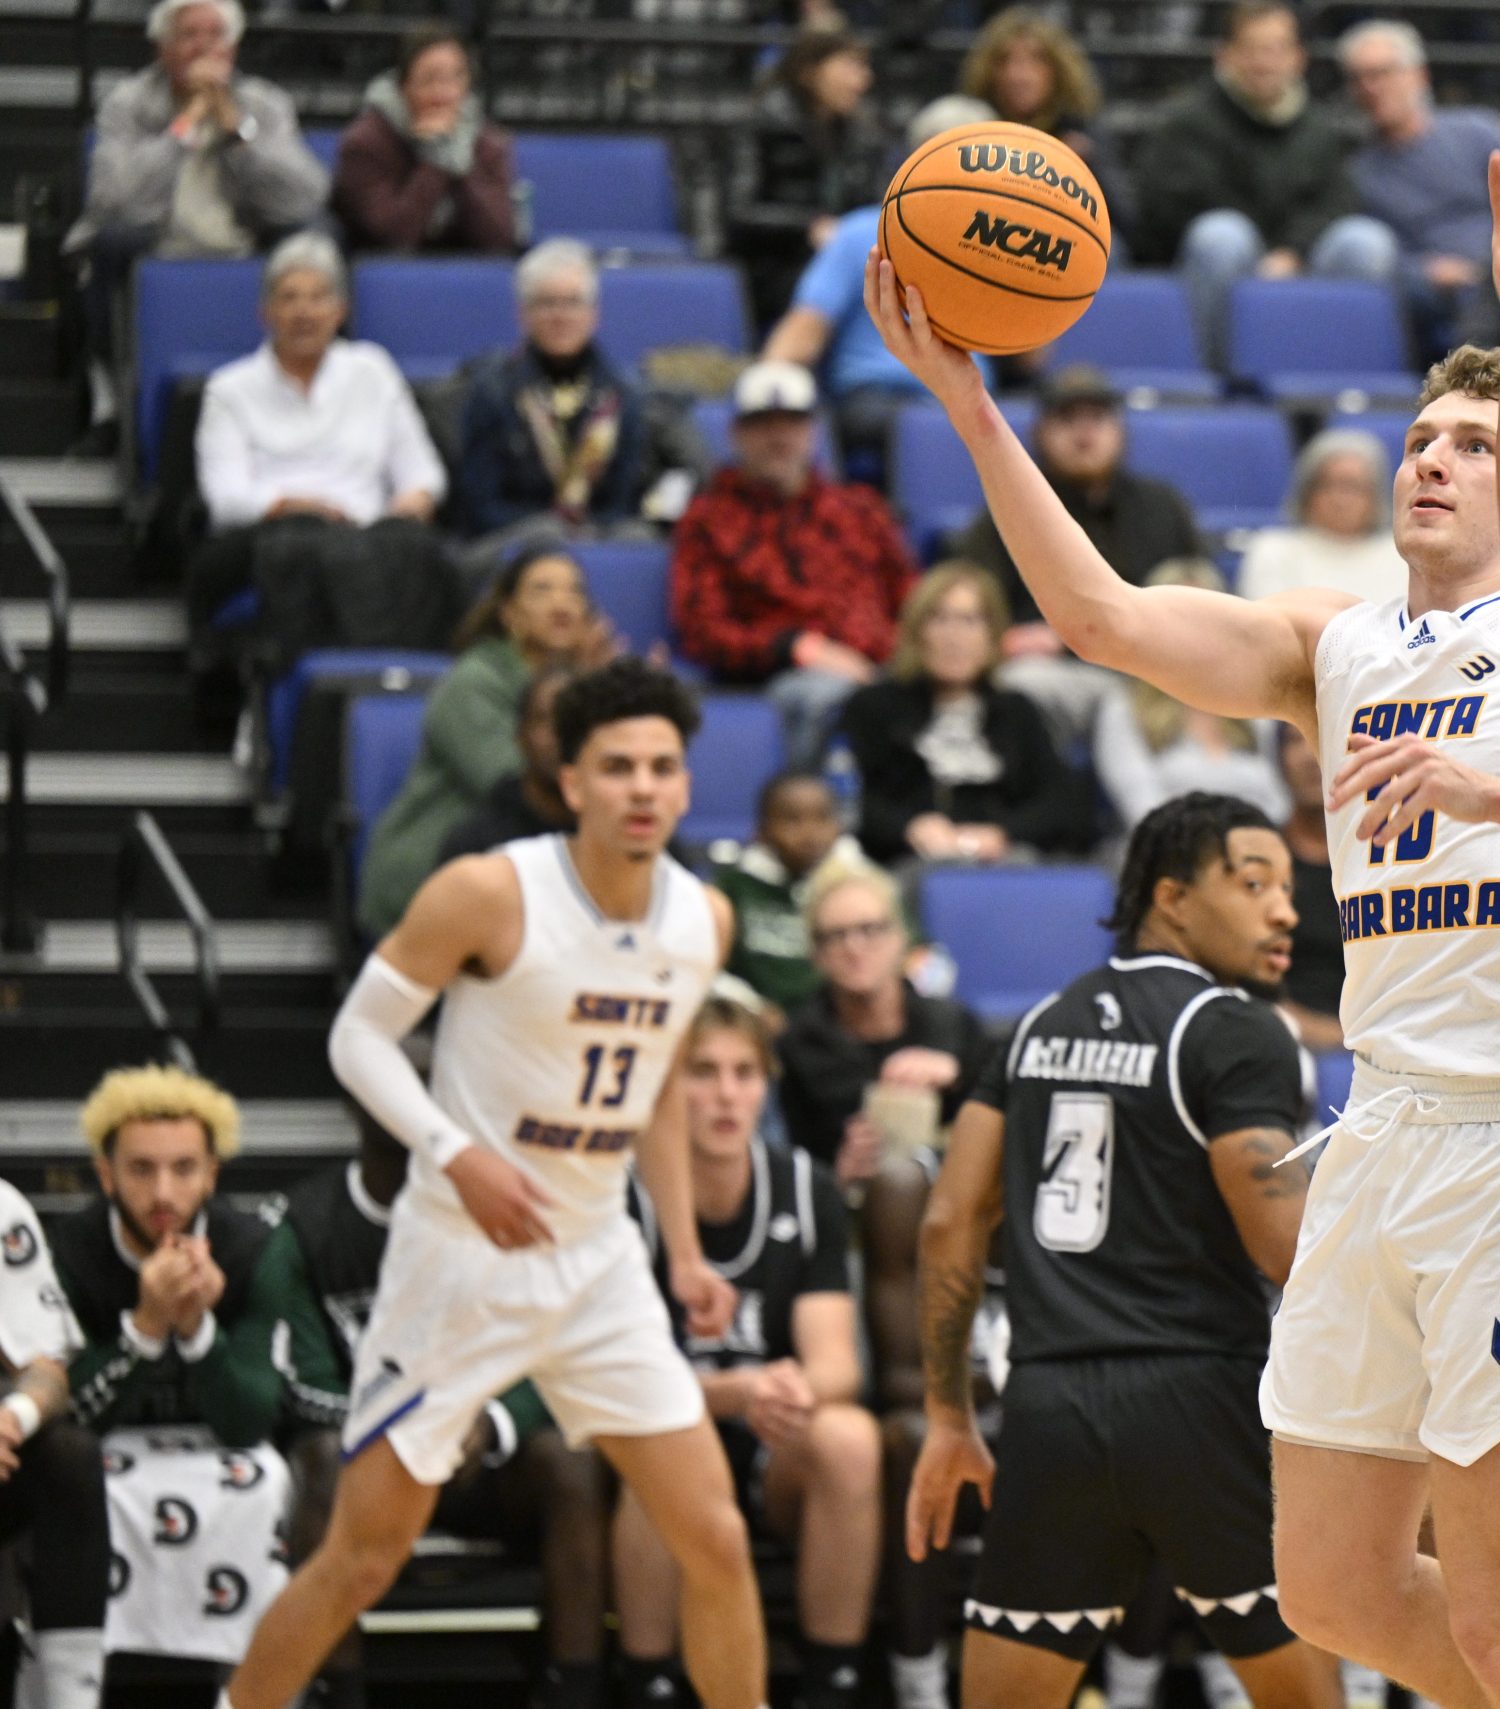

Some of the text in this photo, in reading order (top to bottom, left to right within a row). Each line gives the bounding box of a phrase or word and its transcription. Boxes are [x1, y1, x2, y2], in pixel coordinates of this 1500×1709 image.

[957, 142, 1099, 222] Wilson
[961, 209, 1077, 273] NCAA
[1407, 634, 1436, 650] adidas
[1347, 693, 1489, 755] SANTA
[576, 1040, 640, 1109] 13
[1032, 1090, 1115, 1254] 3
